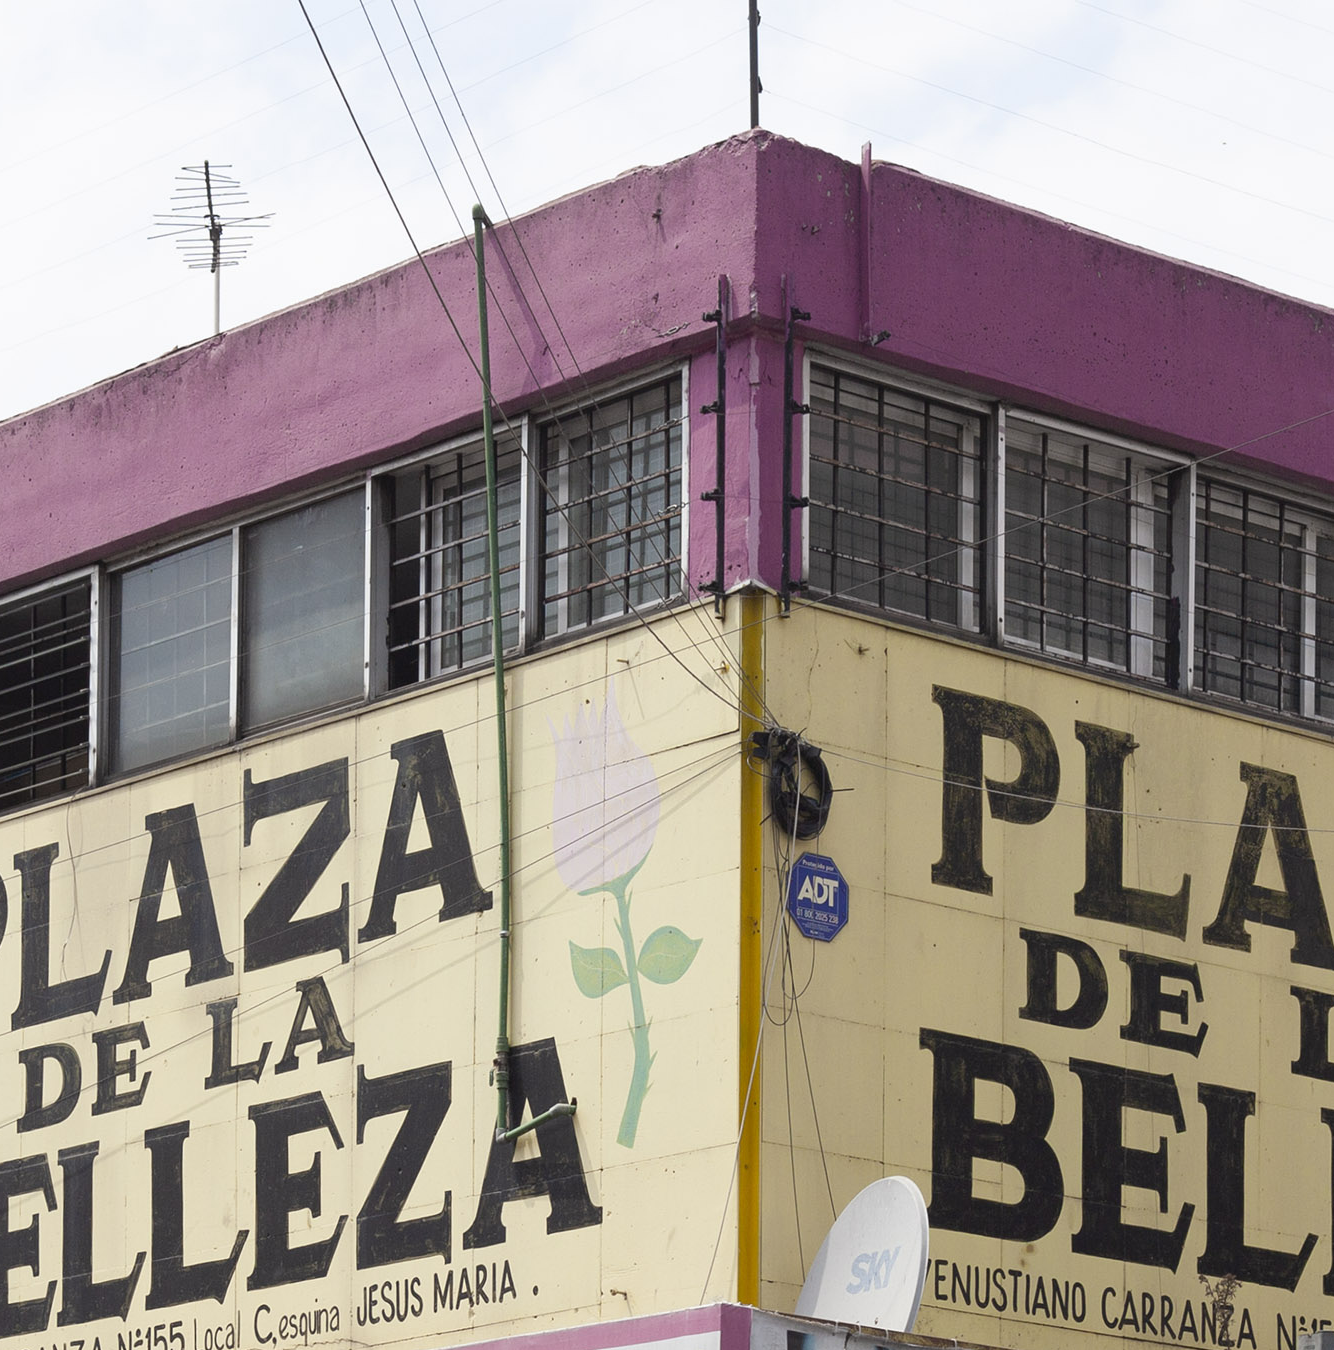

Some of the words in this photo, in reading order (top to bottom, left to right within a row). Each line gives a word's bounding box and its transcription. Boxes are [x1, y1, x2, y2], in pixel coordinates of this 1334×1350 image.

[797, 875, 839, 907] ADT
[1019, 927, 1209, 1058] DE
[17, 1022, 153, 1134] DE
[204, 975, 355, 1090] LA
[846, 1247, 901, 1295] SKY
[357, 1277, 423, 1328] JESUS
[1101, 1287, 1257, 1350] CARRANZA
